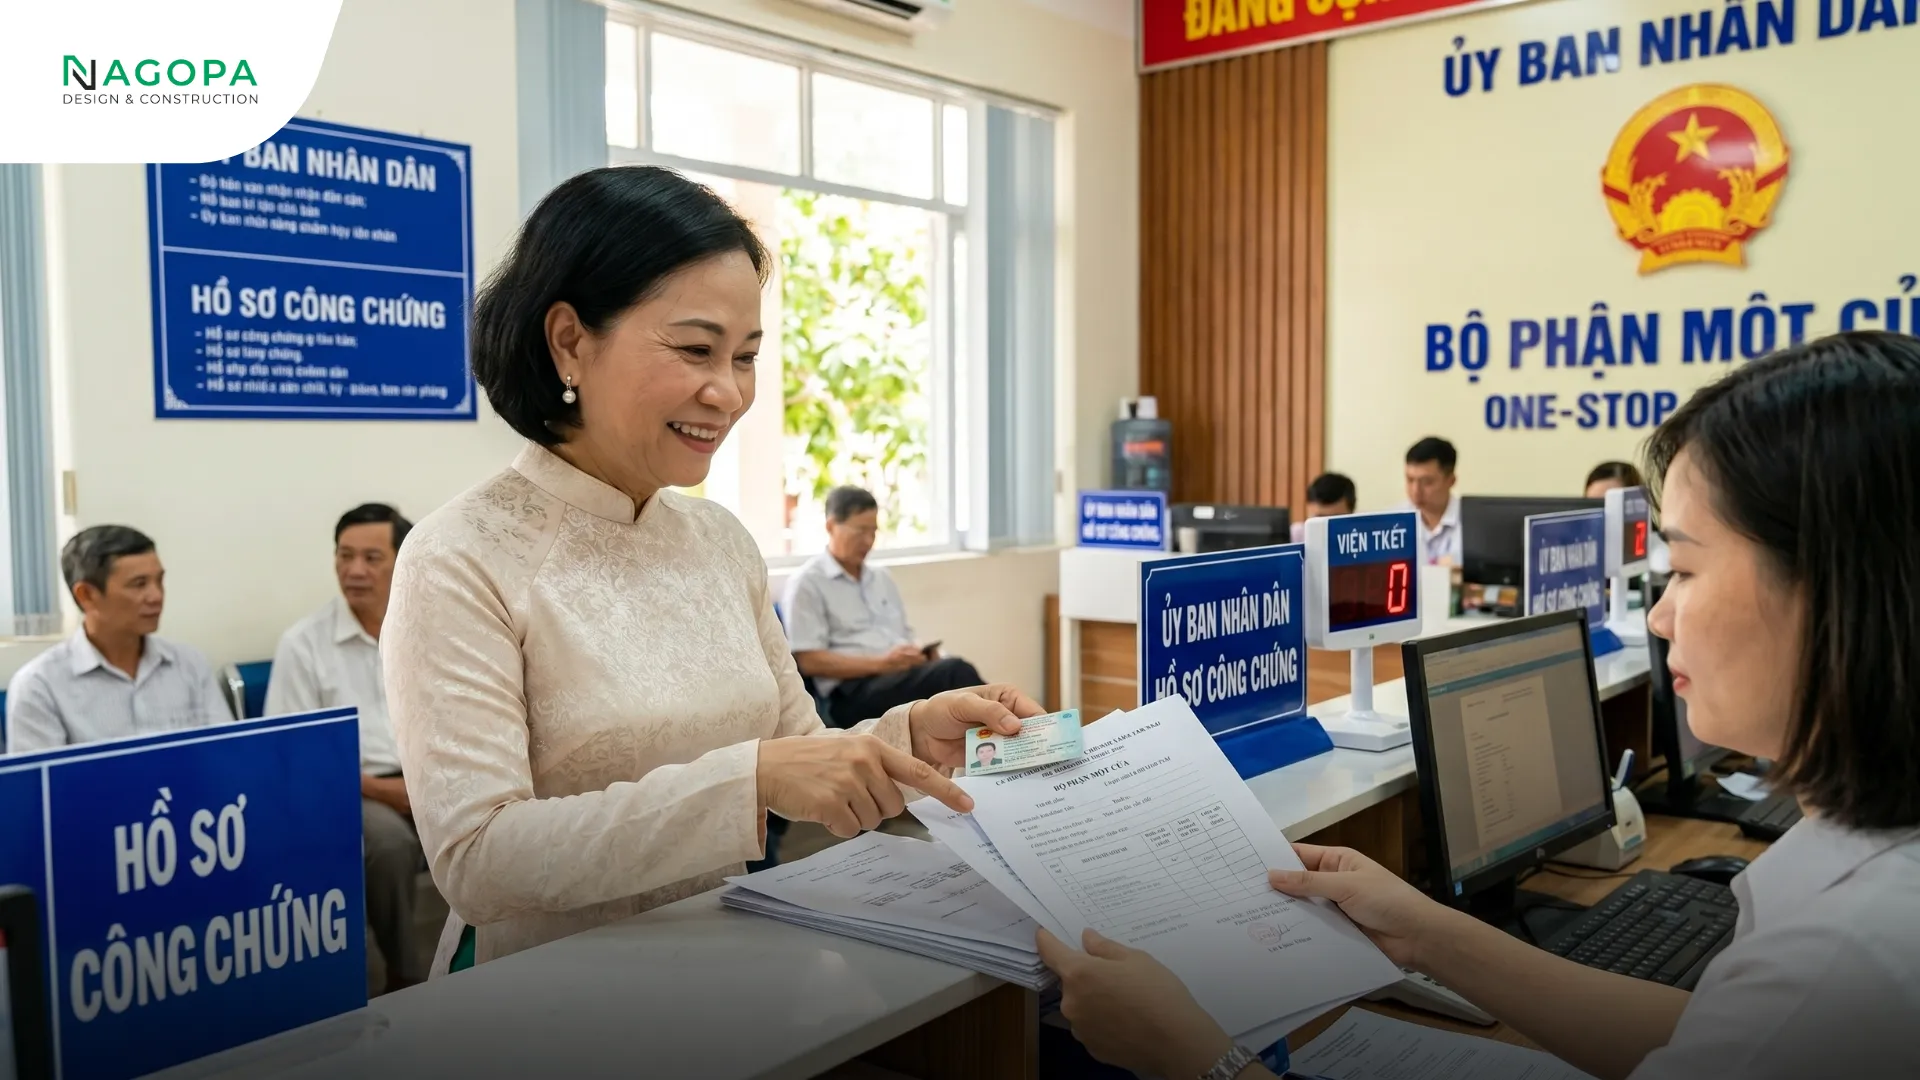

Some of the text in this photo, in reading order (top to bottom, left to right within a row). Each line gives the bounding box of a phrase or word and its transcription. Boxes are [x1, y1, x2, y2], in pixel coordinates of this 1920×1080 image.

[1444, 36, 1502, 97] ỦY
[1519, 26, 1620, 86] BAN
[243, 140, 436, 192] BAN NHÂN DÂN
[239, 286, 277, 319] SƠ
[284, 286, 356, 323] CÔNG
[362, 293, 446, 329] CHỨNG
[1426, 309, 1489, 383] BỘ
[1509, 301, 1660, 379] PHẬN
[1485, 391, 1679, 431] ONE-STOP
[1337, 523, 1407, 559] VIỆN TKẾT
[1162, 580, 1290, 648] ỦY BAN NHÂN DÂN
[1387, 563, 1408, 614] 0
[1182, 664, 1203, 708] SƠ
[1206, 653, 1247, 703] CÔNG
[1251, 641, 1298, 692] CHỨNG
[114, 787, 248, 894] HỒ SƠ
[69, 883, 348, 1023] CÔNG CHỨNG
